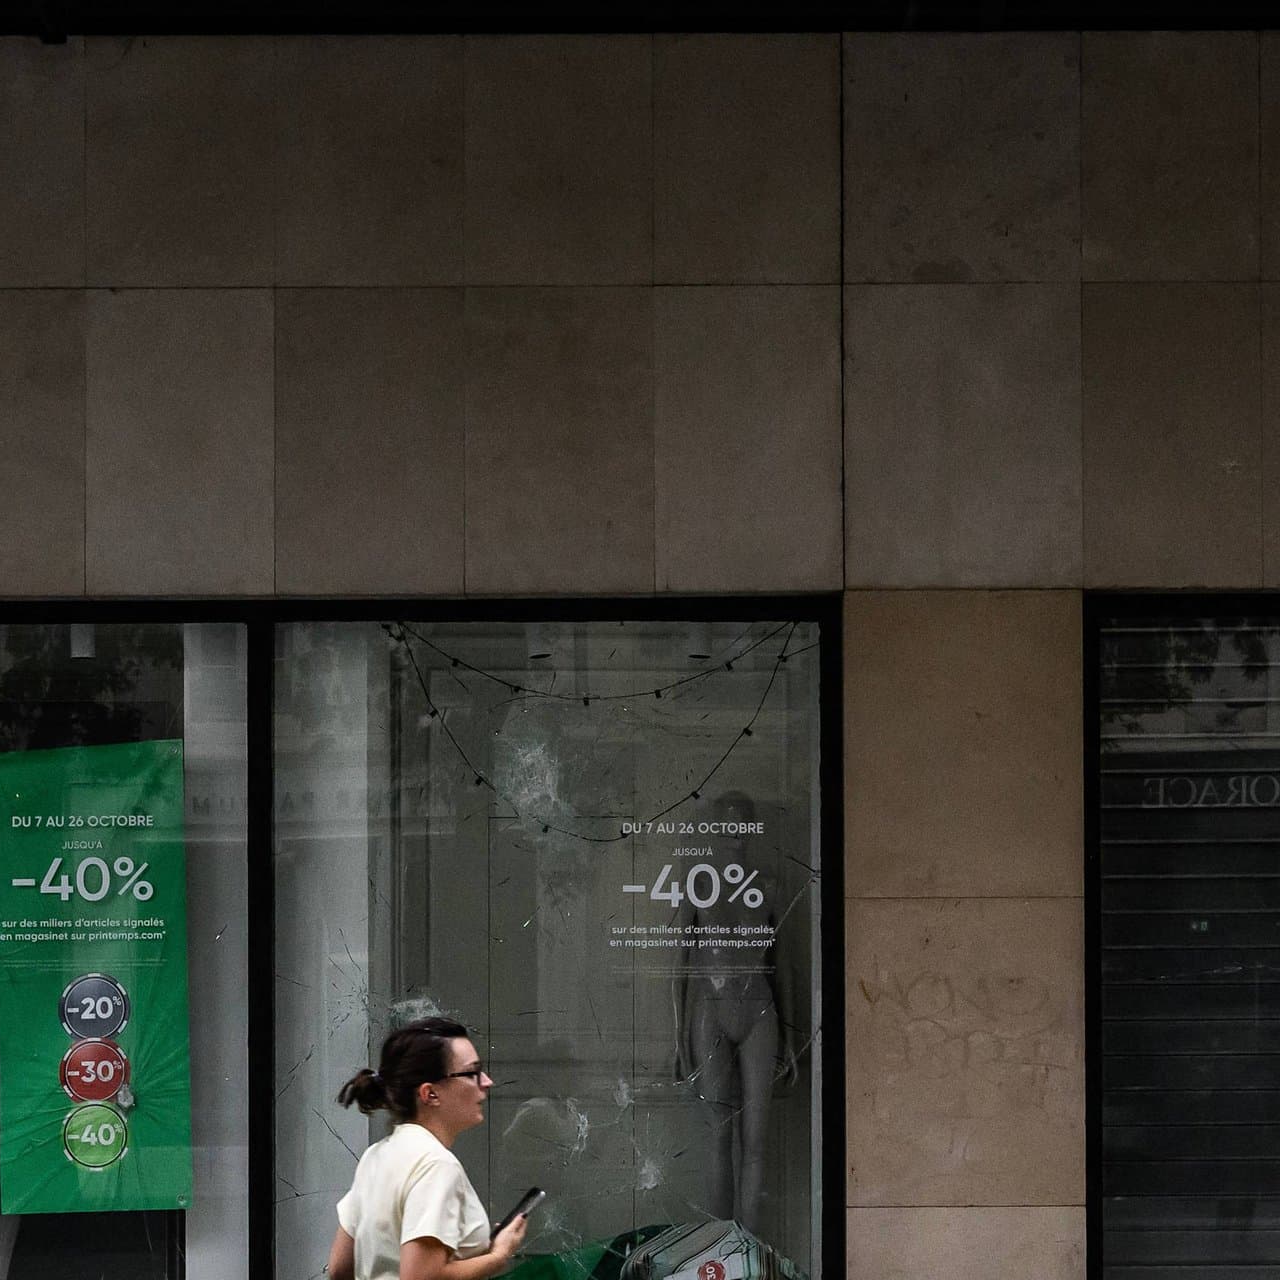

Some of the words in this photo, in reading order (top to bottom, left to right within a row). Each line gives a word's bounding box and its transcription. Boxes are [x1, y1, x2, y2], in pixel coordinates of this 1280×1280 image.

[12, 816, 31, 828] DU
[34, 816, 42, 827] 7
[46, 816, 65, 827] AU
[69, 816, 84, 827] 26
[87, 815, 154, 827] OCTOBRE
[622, 823, 642, 834] DU
[646, 823, 653, 833] 7
[656, 823, 675, 834] AU
[679, 823, 694, 834] 26
[698, 822, 764, 834] OCTOBRE
[12, 856, 154, 901] -40%
[622, 863, 764, 909] -40%
[2, 920, 17, 928] sur
[20, 918, 37, 928] des
[75, 918, 121, 928] d'articles
[123, 917, 165, 929] signalés
[612, 926, 627, 934] sur
[629, 925, 647, 934] des
[685, 924, 730, 934] d'articles
[733, 924, 774, 936] signalés
[0, 933, 13, 941] en
[610, 939, 623, 947] en
[681, 939, 696, 947] sur
[67, 995, 122, 1020] -20%
[67, 1060, 122, 1083] -30%
[67, 1123, 123, 1146] -40%
